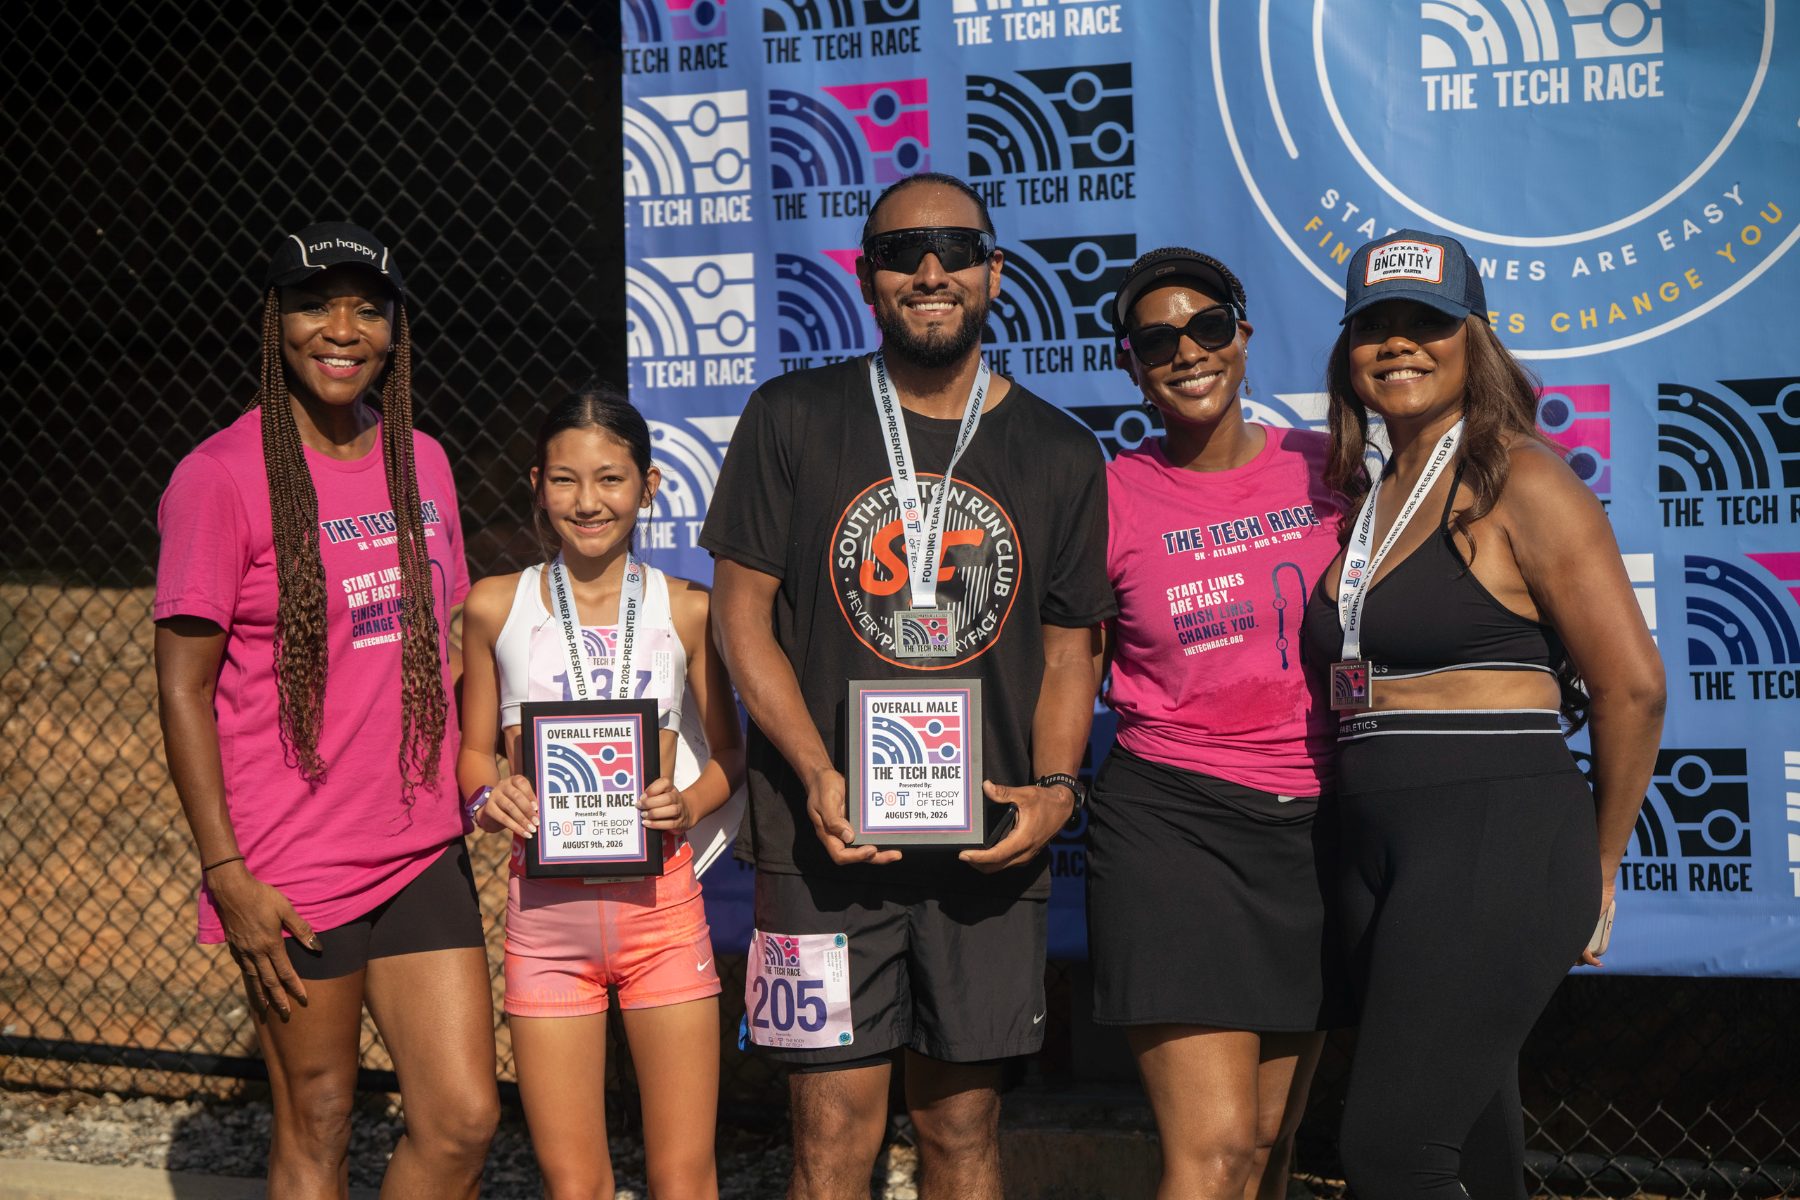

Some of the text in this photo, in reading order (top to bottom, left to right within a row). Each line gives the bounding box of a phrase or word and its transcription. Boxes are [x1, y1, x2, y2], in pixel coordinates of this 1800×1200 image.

[953, 5, 1122, 46] THE TECH RACE
[679, 42, 728, 72] RACE
[763, 26, 921, 64] THE TECH RACE
[1421, 60, 1664, 111] THE TECH RACE
[1017, 178, 1068, 206] TECH
[1079, 172, 1136, 201] RACE
[640, 199, 693, 227] TECH
[701, 195, 753, 224] RACE
[773, 190, 871, 221] THE TECH
[1320, 184, 1744, 281] STA NES ARE EASY
[309, 238, 377, 260] run happy
[1374, 253, 1433, 271] BNCNTRY
[1304, 201, 1783, 332] FIN CHANGE YOU
[643, 360, 696, 388] TECH
[704, 358, 756, 386] RACE
[1023, 346, 1073, 374] TECH
[1083, 344, 1115, 371] RA
[875, 358, 888, 394] MEMBER
[882, 395, 904, 466] 2026-PRESENTED
[898, 467, 908, 481] BY
[922, 533, 936, 583] FOUNDING
[930, 506, 940, 531] YEAR
[978, 386, 985, 400] BY
[1659, 498, 1704, 527] THE
[1717, 495, 1778, 525] TECH
[321, 517, 363, 544] THE
[638, 521, 677, 549] THE
[1162, 504, 1320, 555] THE TECH RACE
[1350, 581, 1366, 631] FOUNDING
[1402, 449, 1447, 519] 2026-PRESENTED
[1443, 435, 1454, 449] BY
[1358, 533, 1367, 546] BY
[838, 496, 882, 570] SOUTH
[965, 496, 1007, 538] RUN
[994, 539, 1014, 597] CLUB
[1195, 551, 1206, 561] 5K
[1213, 545, 1247, 558] ATLANTA
[1254, 537, 1270, 549] AUG
[1282, 531, 1302, 543] 2026
[342, 572, 376, 593] START
[552, 562, 562, 583] YEAR
[1167, 573, 1245, 601] START LINES
[348, 583, 400, 608] ARE EASY.
[556, 584, 570, 619] MEMBER
[1170, 590, 1235, 616] ARE EASY.
[351, 602, 384, 624] FINISH
[352, 617, 394, 638] CHANGE
[1173, 601, 1254, 631] FINISH LINES
[620, 611, 636, 685] 2026-PRESENTED
[628, 597, 637, 610] BY
[1178, 615, 1260, 645] CHANGE YOU.
[563, 620, 587, 699] 2026-PRESENTED
[1183, 634, 1244, 657] THETECHRACE.ORG
[593, 658, 608, 666] TECH
[1690, 671, 1735, 700] THE
[872, 701, 958, 713] OVERALL MALE
[547, 727, 631, 739] OVERALL FEMALE
[873, 766, 961, 780] THE TECH RACE
[549, 794, 635, 809] THE TECH RACE
[914, 811, 929, 819] 9th,
[930, 811, 948, 819] 2026
[610, 819, 634, 827] BODY
[562, 840, 623, 849] AUGUST 9th, 2026
[1619, 863, 1752, 892] TECH RACE
[775, 967, 785, 975] TECH
[787, 967, 800, 976] RACE
[752, 976, 827, 1032] 205
